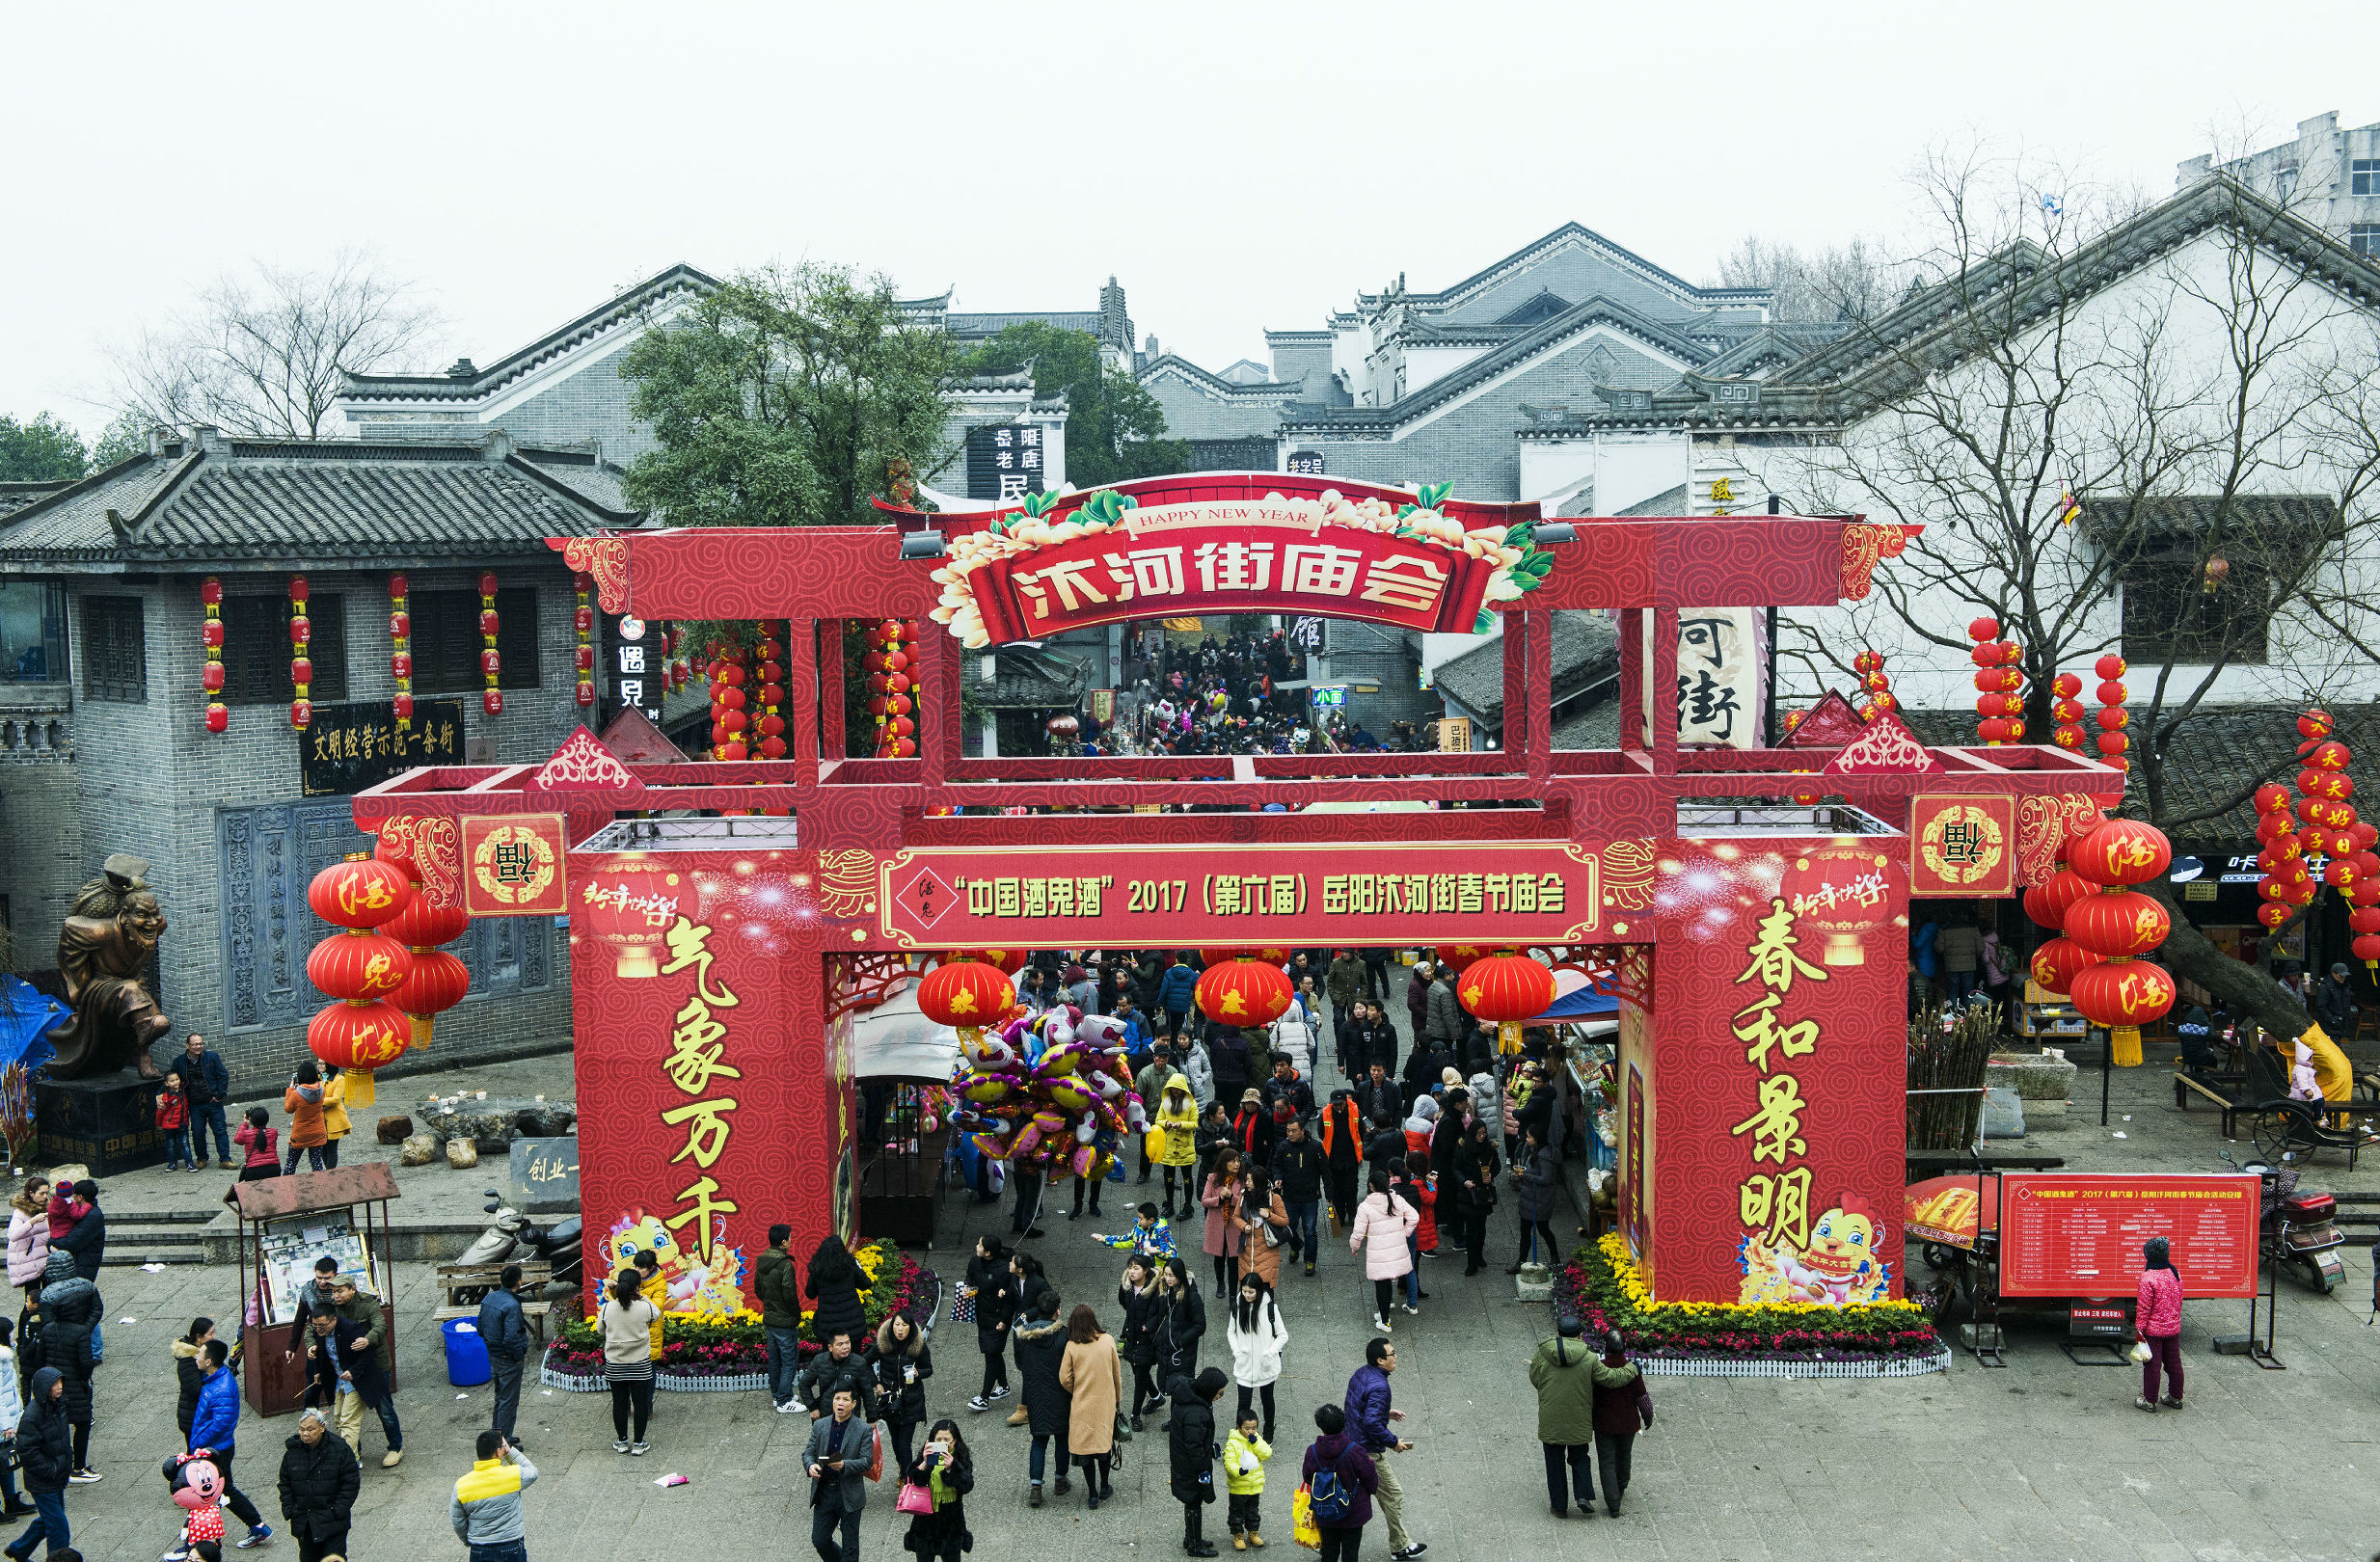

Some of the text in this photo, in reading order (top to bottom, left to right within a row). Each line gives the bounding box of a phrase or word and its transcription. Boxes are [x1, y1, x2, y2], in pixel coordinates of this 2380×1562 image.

[1140, 507, 1310, 527] HAPPY NEW YEAR
[1316, 687, 1343, 705] 小面
[954, 875, 1114, 918] “中国酒鬼酒”
[1127, 879, 1187, 912] 2017
[662, 915, 741, 1265] 气象万千
[1731, 897, 1829, 1252] 春和景明
